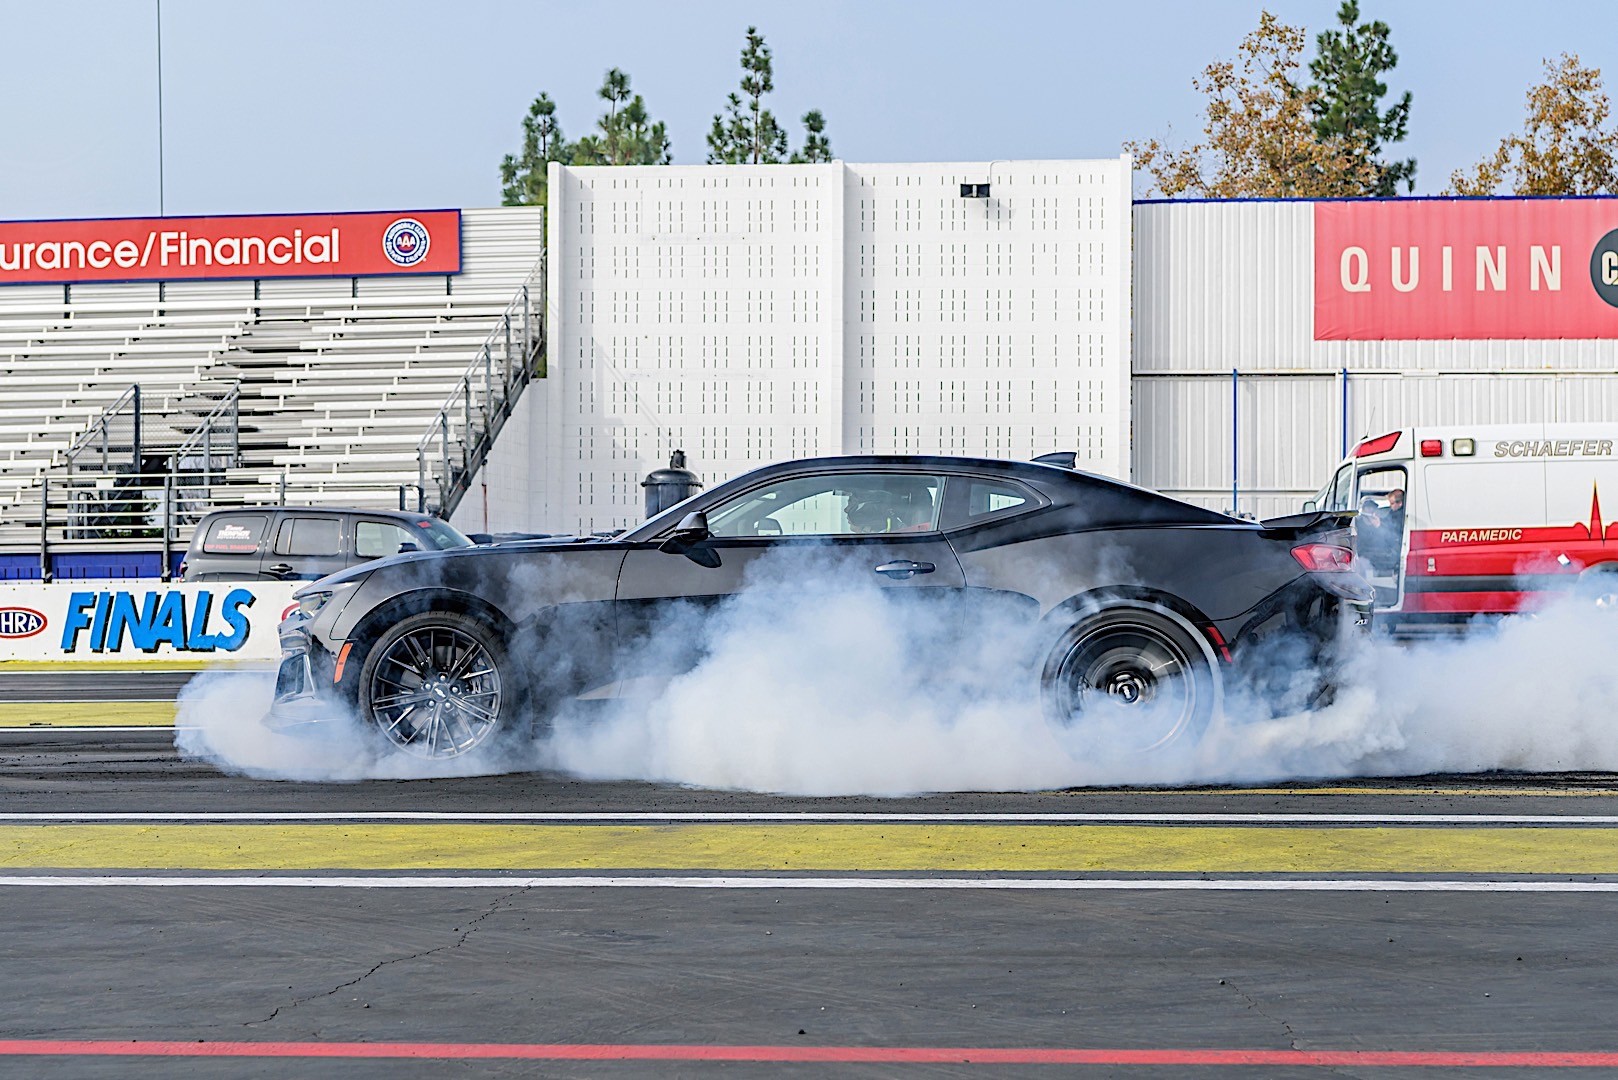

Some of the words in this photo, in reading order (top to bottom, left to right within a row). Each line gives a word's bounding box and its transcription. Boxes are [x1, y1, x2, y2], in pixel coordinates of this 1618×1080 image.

[396, 234, 416, 248] AAA
[1340, 245, 1562, 293] QUINN
[1493, 439, 1614, 458] SCHAEFER
[1440, 528, 1523, 543] PARAMEDIC
[61, 588, 257, 653] FINALS
